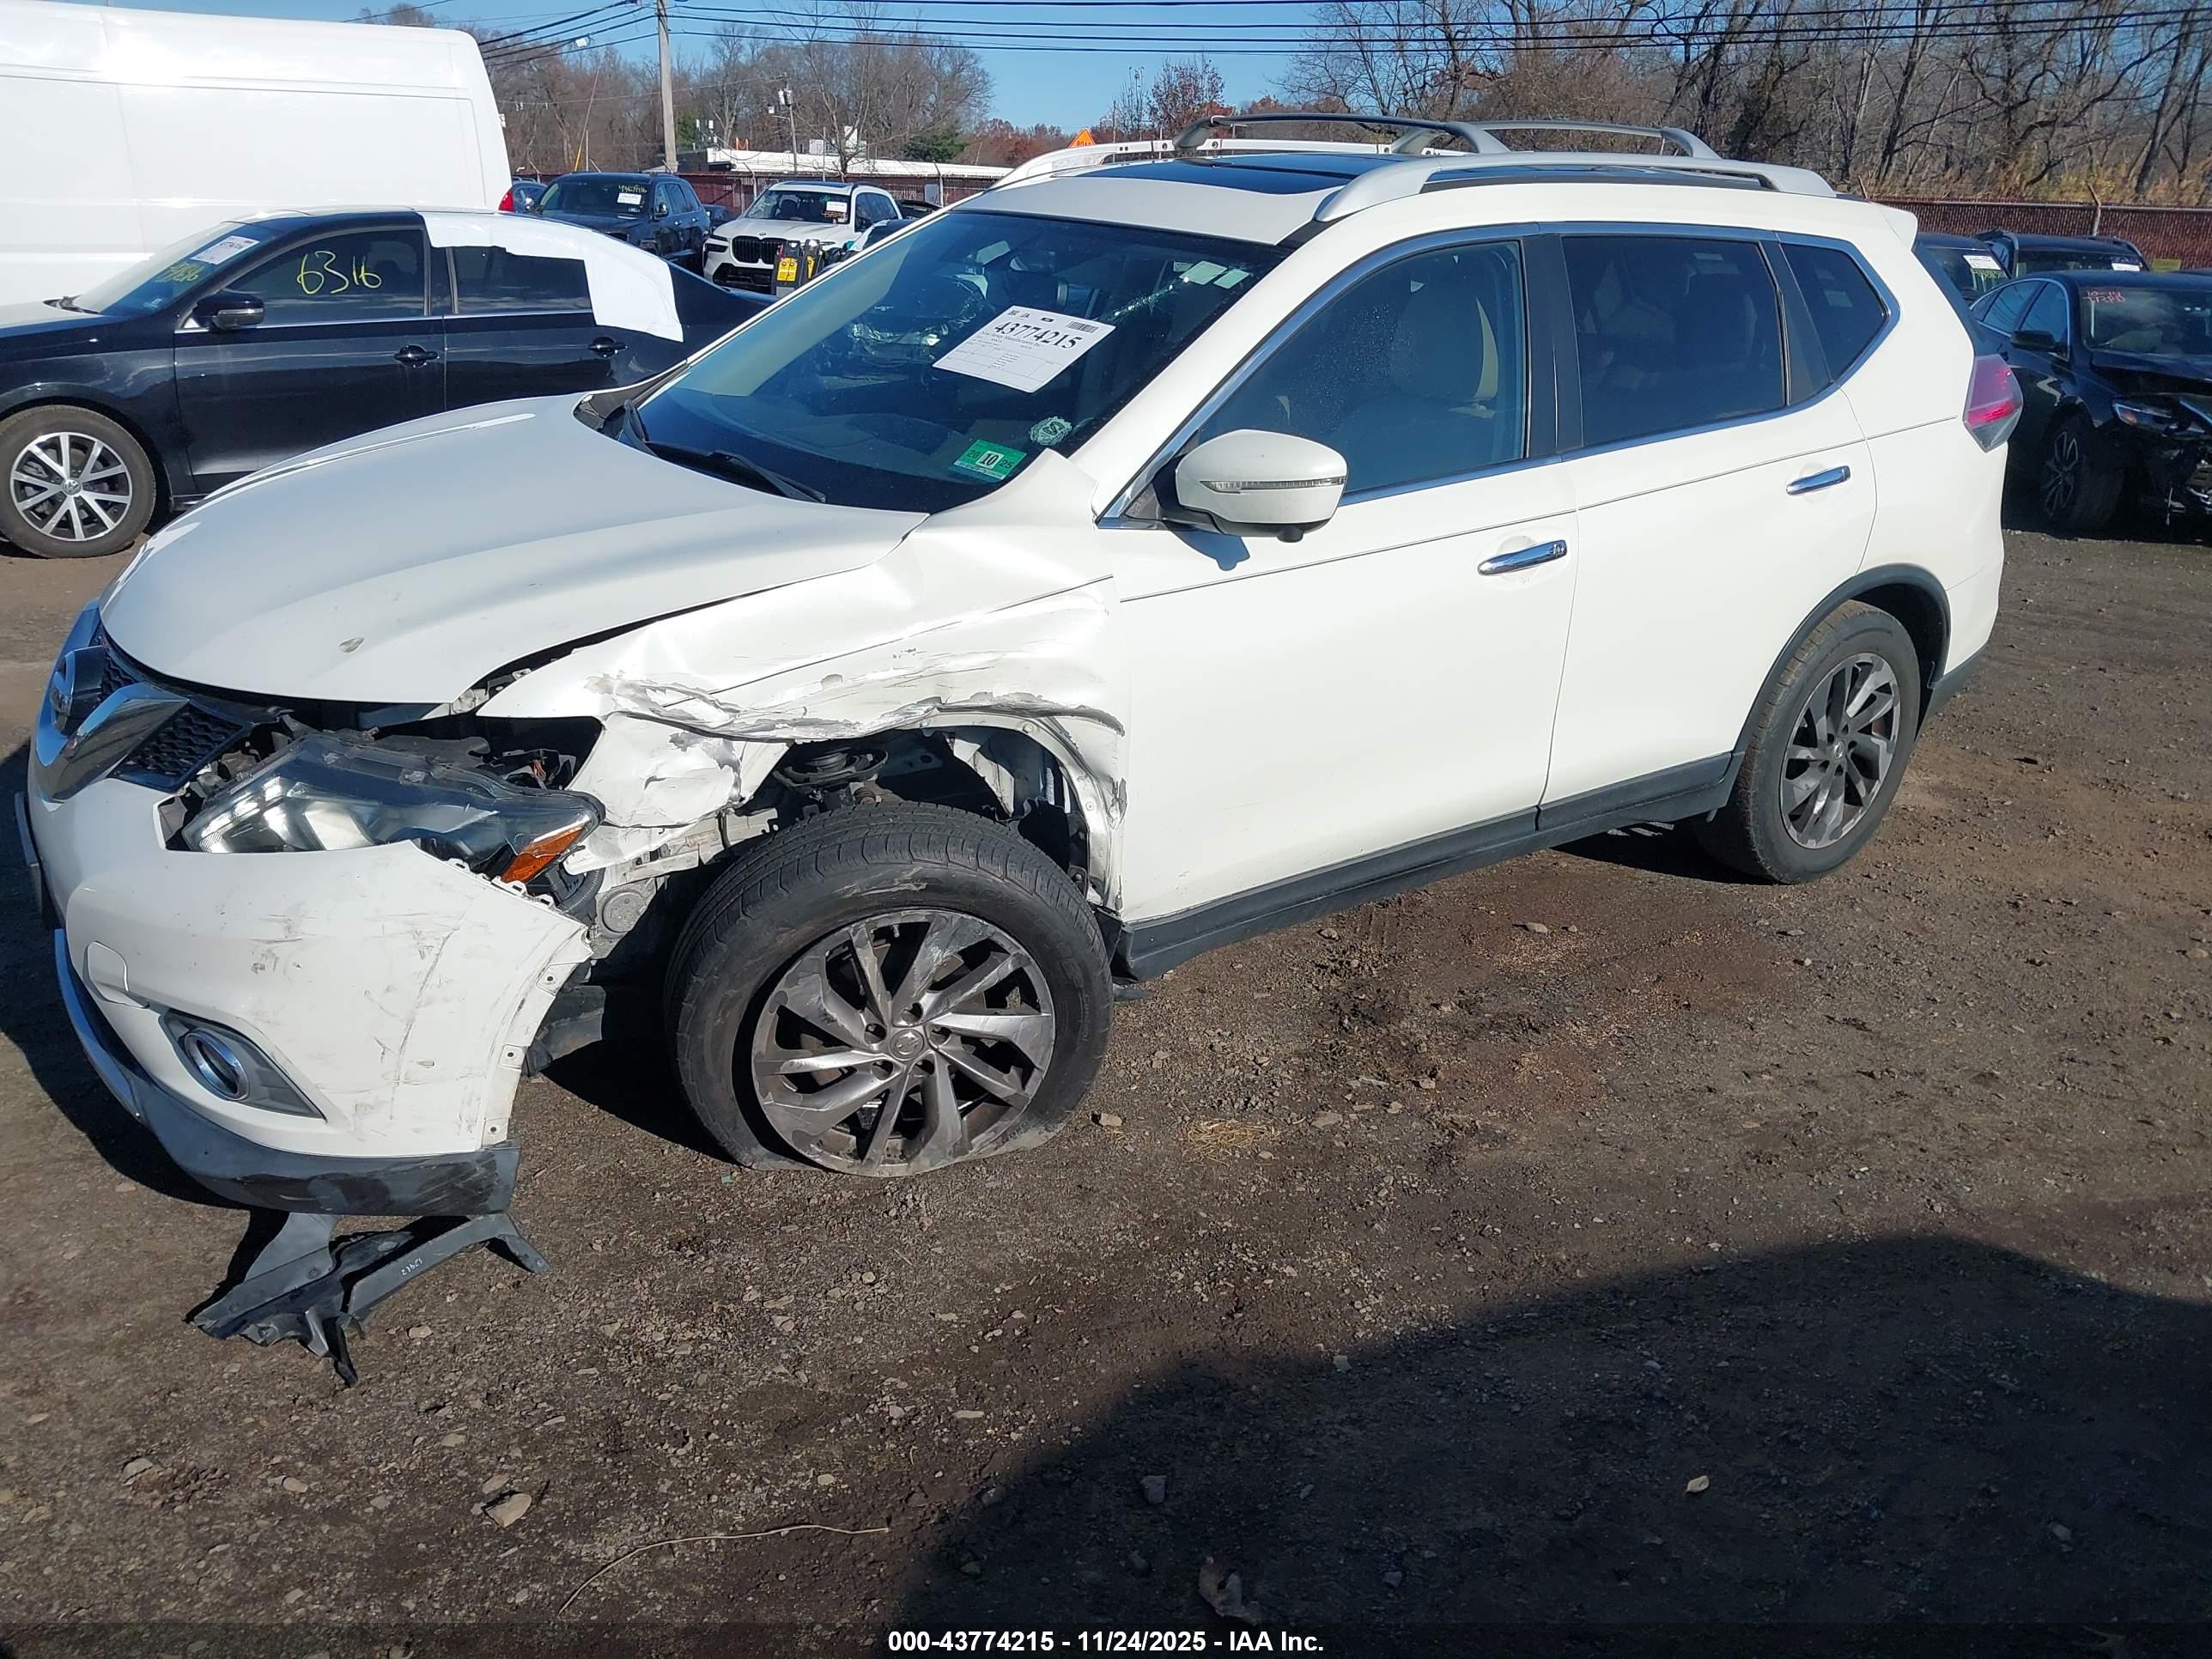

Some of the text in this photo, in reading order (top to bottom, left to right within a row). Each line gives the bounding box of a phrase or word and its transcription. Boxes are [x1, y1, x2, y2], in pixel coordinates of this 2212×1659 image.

[296, 250, 382, 295] 6316
[994, 321, 1083, 349] 43774215
[967, 449, 1015, 469] 20 10 25
